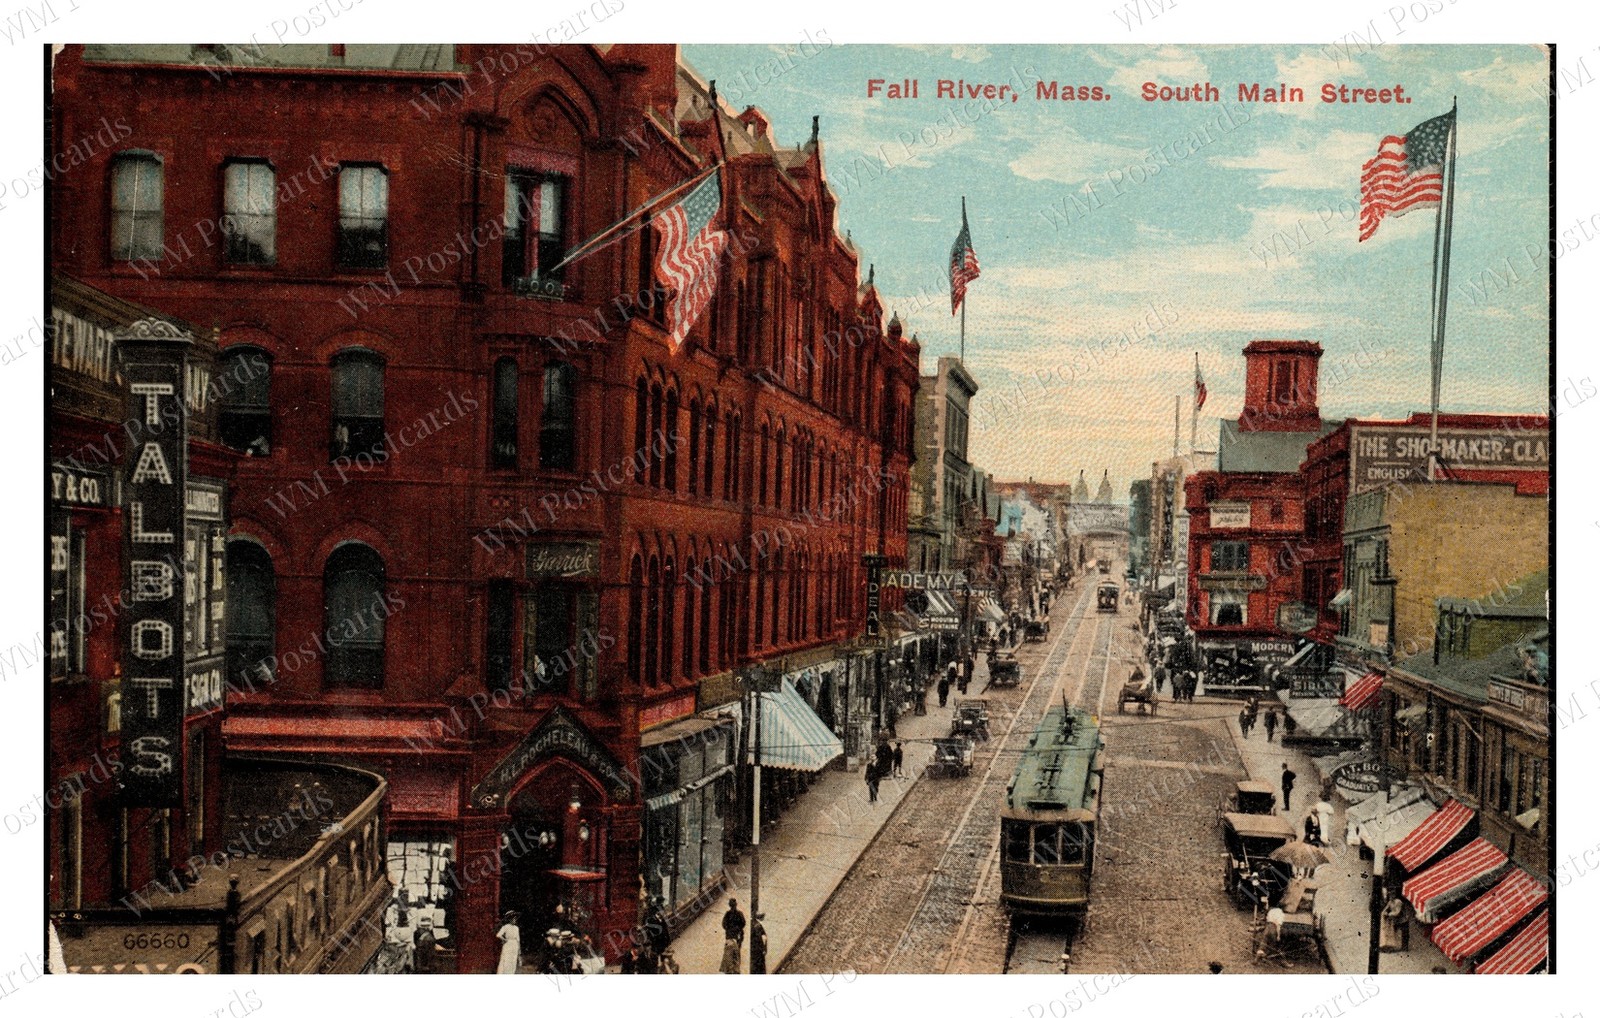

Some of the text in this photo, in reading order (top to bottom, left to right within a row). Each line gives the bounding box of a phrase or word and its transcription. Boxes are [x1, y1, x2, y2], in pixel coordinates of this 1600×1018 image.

[1358, 437, 1389, 458] THE
[51, 473, 100, 504] Y & CO.
[130, 382, 175, 777] TALBOTS
[1251, 642, 1296, 656] MODERN
